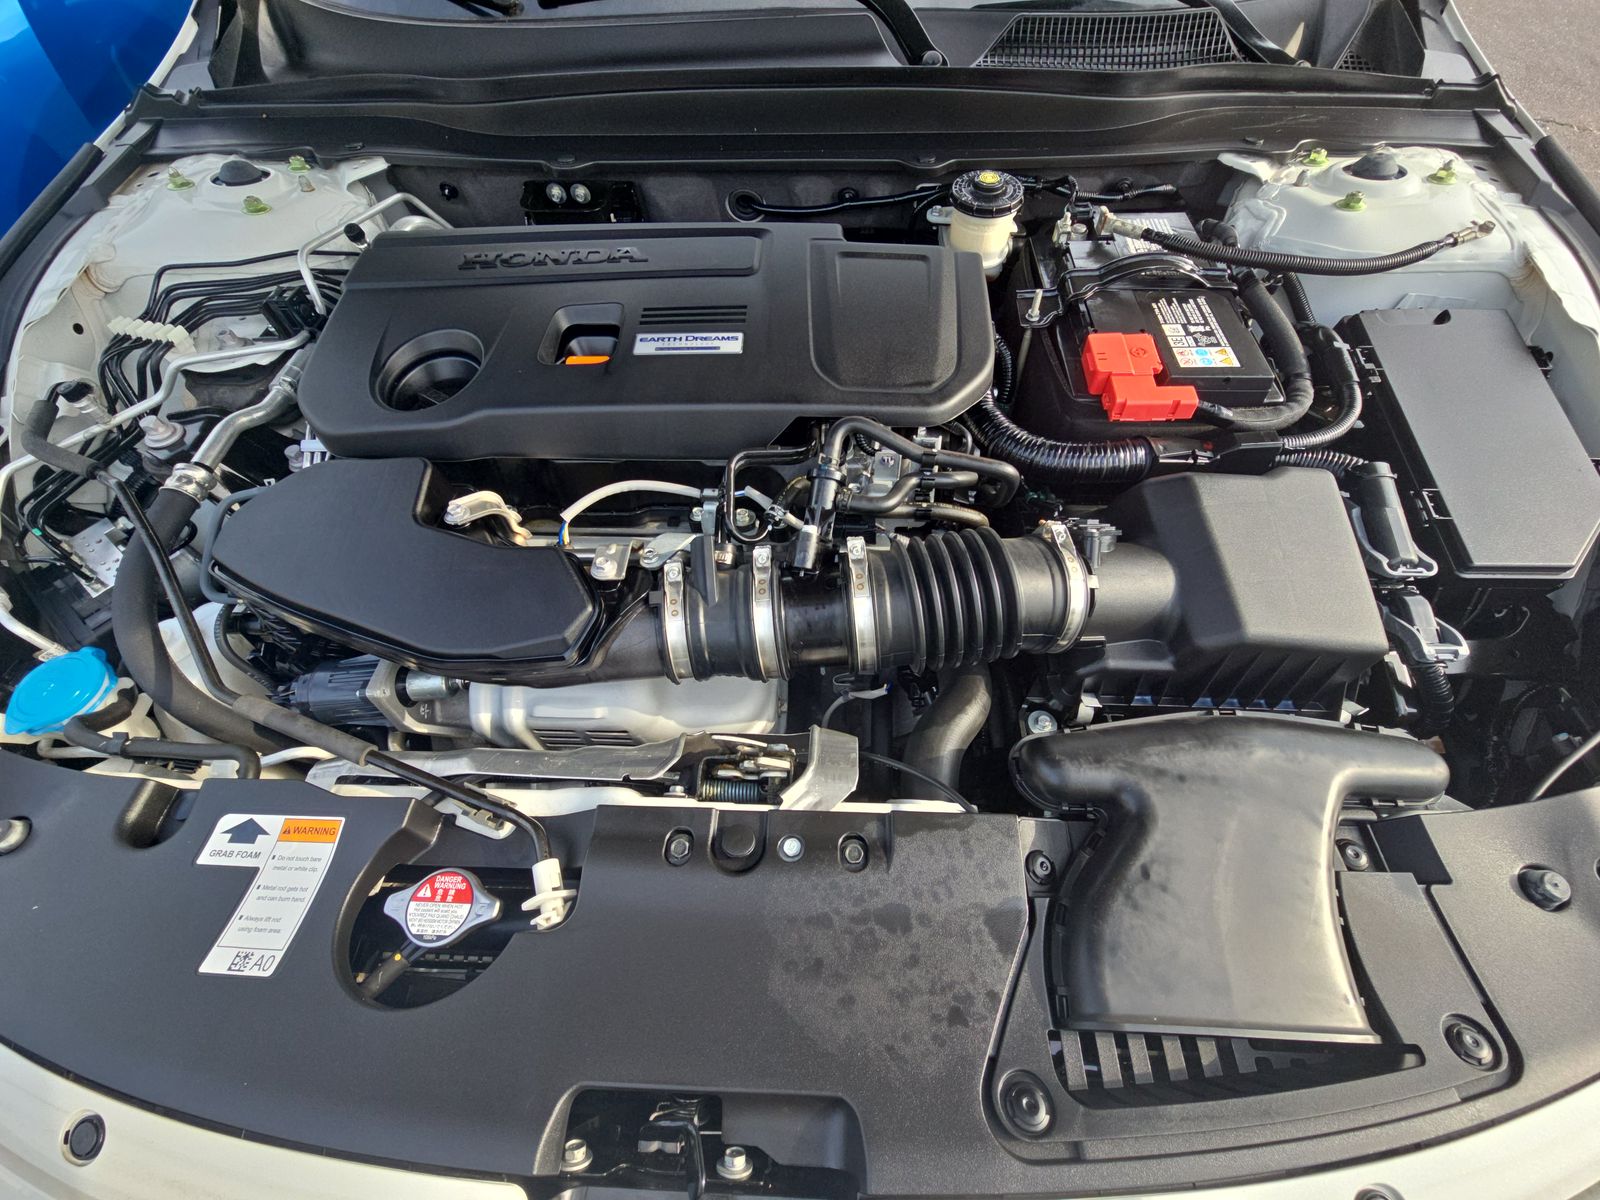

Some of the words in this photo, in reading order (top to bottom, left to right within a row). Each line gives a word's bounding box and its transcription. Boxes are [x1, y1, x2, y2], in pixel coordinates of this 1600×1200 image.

[457, 246, 649, 271] HONDA
[293, 825, 336, 836] WARNING
[209, 849, 235, 858] GRAB
[235, 850, 261, 859] FOAM
